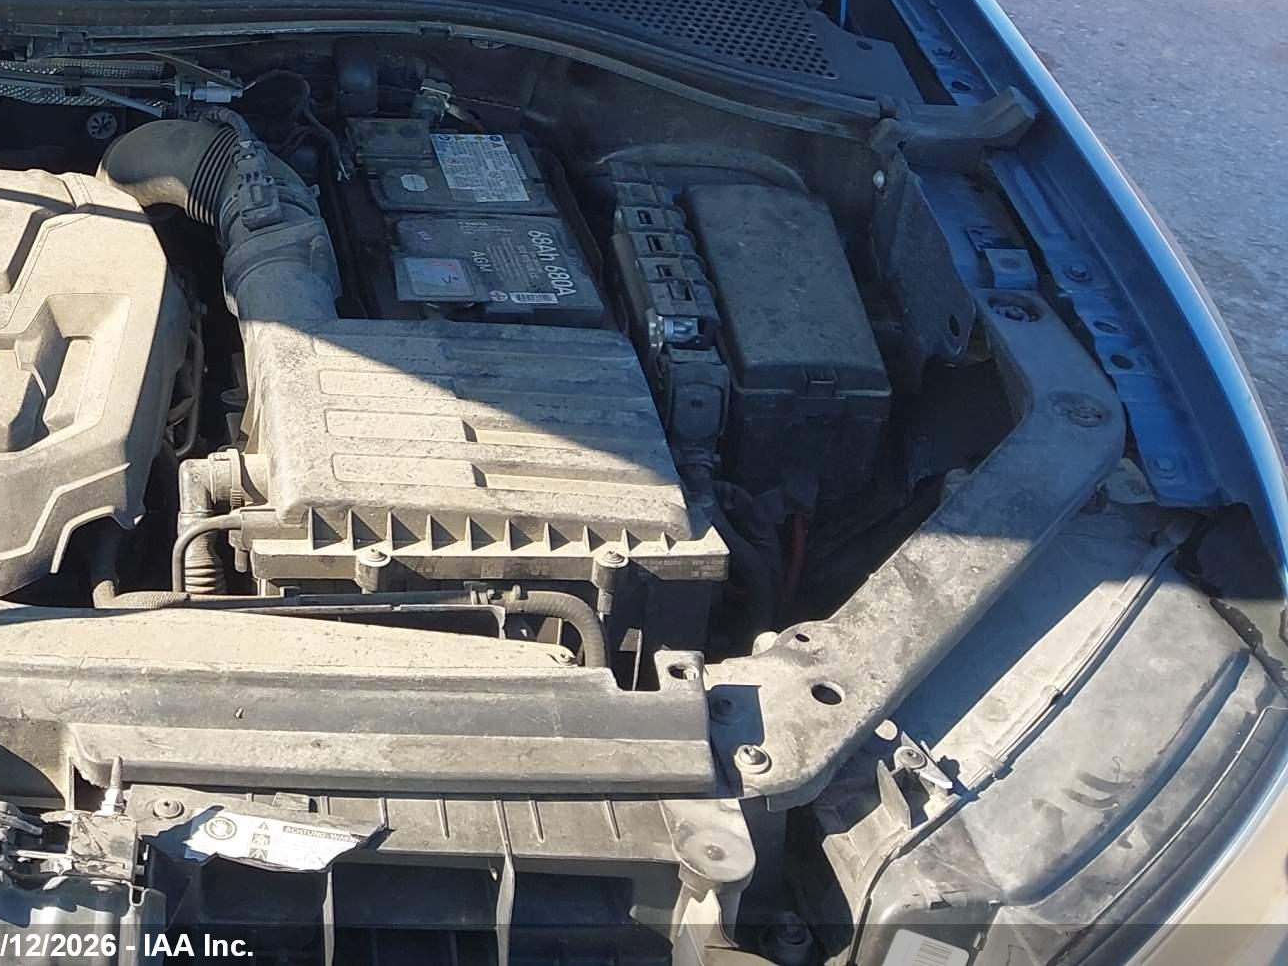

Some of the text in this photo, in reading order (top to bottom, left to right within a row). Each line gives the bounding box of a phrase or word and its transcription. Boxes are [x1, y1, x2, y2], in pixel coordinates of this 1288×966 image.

[470, 249, 494, 273] AGM
[528, 230, 560, 262] 68Ah
[544, 264, 577, 297] 680A
